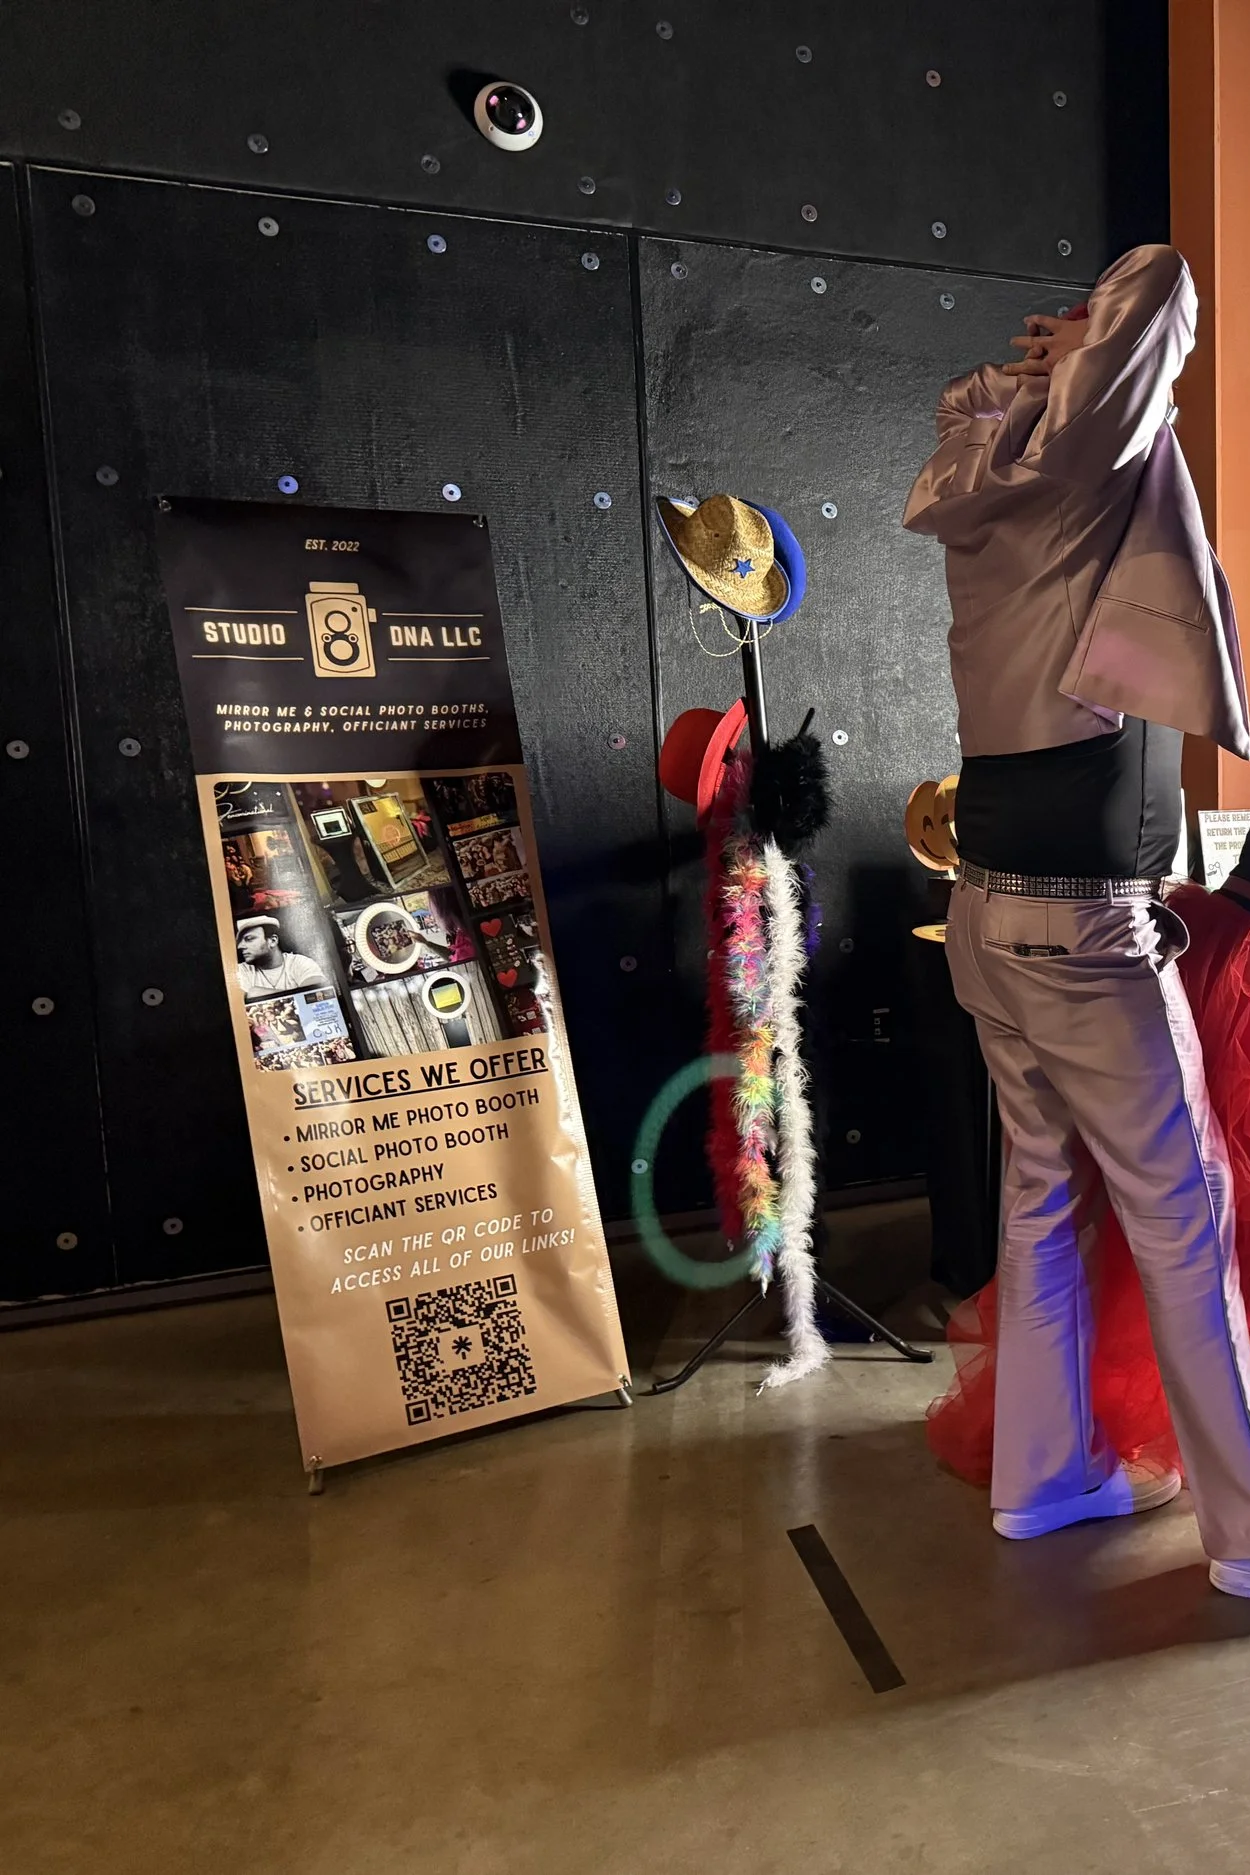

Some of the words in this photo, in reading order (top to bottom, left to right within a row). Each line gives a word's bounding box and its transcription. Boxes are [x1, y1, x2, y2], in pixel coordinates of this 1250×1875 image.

[305, 539, 328, 551] EST.
[332, 540, 360, 552] 2022
[203, 621, 286, 645] STUDIO
[390, 625, 434, 647] DNA
[442, 626, 482, 647] LLC
[216, 704, 270, 717] MIRROR
[277, 706, 297, 717] ME
[304, 705, 313, 717] &
[320, 705, 371, 717] SOCIAL
[379, 704, 425, 716] PHOTO
[431, 703, 489, 715] BOOTHS,
[224, 720, 335, 733] PHOTOGRAPHY,
[343, 719, 417, 732] OFFICIANT
[424, 718, 487, 731] SERVICES
[1204, 814, 1231, 823] PLEASE
[1206, 827, 1233, 836] RETURN
[1214, 842, 1228, 850] THE
[293, 1069, 411, 1105] SERVICES
[420, 1062, 460, 1088] WE
[469, 1047, 546, 1079] OFFER
[296, 1113, 366, 1143] MIRROR
[372, 1112, 400, 1132] ME
[407, 1101, 469, 1126] PHOTO
[476, 1088, 539, 1115] BOOTH
[300, 1147, 368, 1173] SOCIAL
[374, 1135, 438, 1161] PHOTO
[445, 1123, 509, 1149] BOOTH
[304, 1163, 445, 1203] PHOTOGRAPHY
[310, 1200, 407, 1233] OFFICIANT
[415, 1183, 498, 1214] SERVICES
[343, 1241, 393, 1264] SCAN
[402, 1232, 433, 1254] THE
[441, 1224, 466, 1246] QR
[474, 1213, 522, 1239] CODE
[531, 1208, 554, 1226] TO
[331, 1265, 402, 1294] ACCESS
[410, 1258, 440, 1277] ALL
[449, 1250, 472, 1269] OF
[480, 1242, 514, 1263] OUR
[522, 1229, 576, 1255] LINKS!
